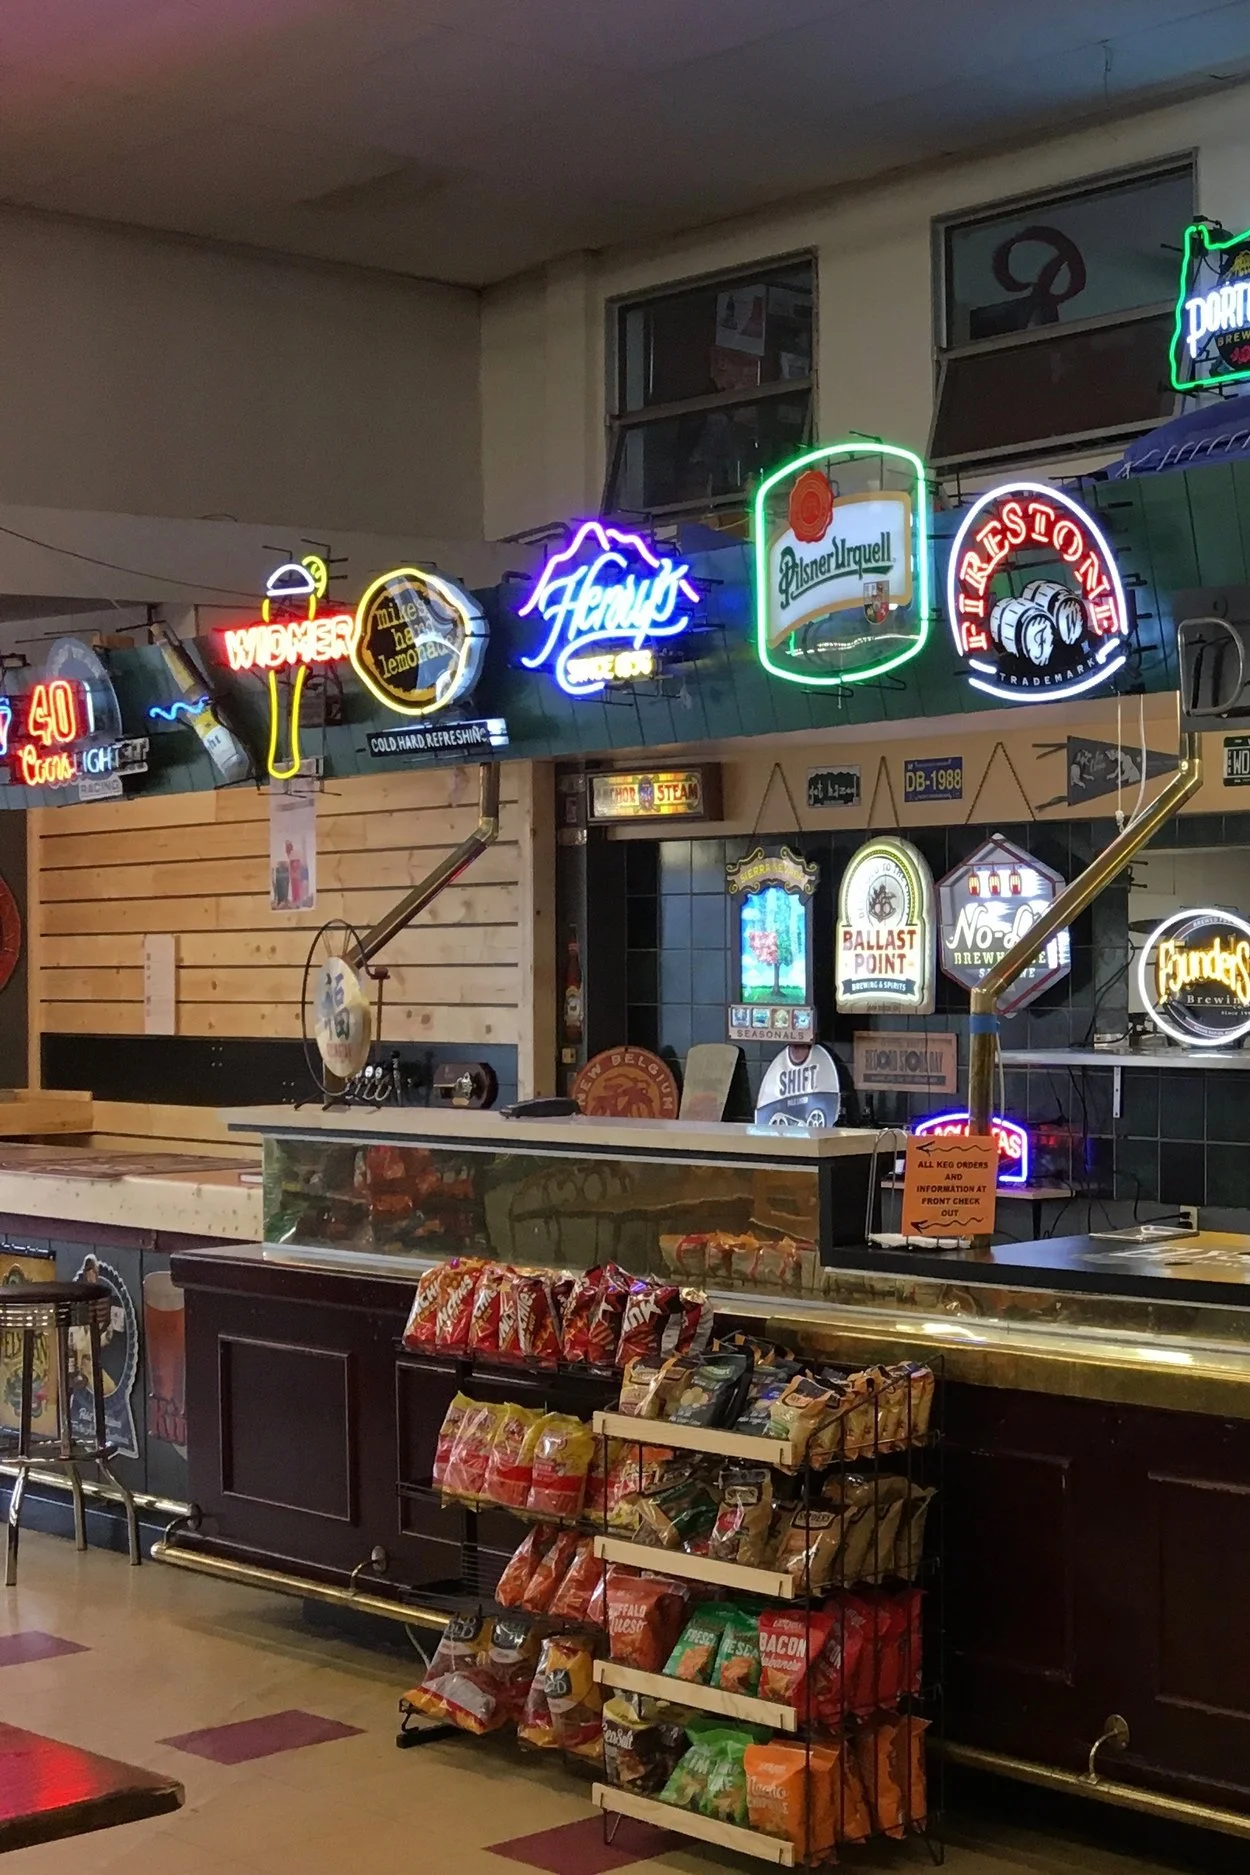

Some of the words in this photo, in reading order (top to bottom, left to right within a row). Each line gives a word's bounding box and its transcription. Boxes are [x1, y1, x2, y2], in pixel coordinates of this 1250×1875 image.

[778, 545, 835, 610] Pilsner
[831, 532, 892, 580] Urquell
[959, 501, 1119, 653] FIRESTONE
[999, 658, 1096, 687] TRADEMARK
[28, 680, 77, 746] 40
[18, 744, 74, 787] Coors
[905, 768, 963, 792] DB-1988
[657, 783, 698, 802] STEAM
[842, 929, 918, 951] BALLAST
[853, 953, 908, 975] POINT
[851, 981, 879, 992] BREWING
[883, 982, 907, 992] SPIRITS
[736, 1028, 805, 1041] SEASONALS
[577, 1066, 602, 1107] NEW
[610, 1053, 675, 1111] BELGIUM
[778, 1064, 819, 1097] SHIFT
[918, 1160, 934, 1169] ALL
[956, 1160, 989, 1169] ORDERS
[944, 1173, 963, 1181] AND
[916, 1185, 975, 1193] INFORMATION
[977, 1185, 987, 1193] AT
[921, 1197, 951, 1205] FRONT
[952, 1197, 981, 1205] CHECK
[940, 1209, 959, 1217] OUT
[759, 1632, 807, 1658] BACON
[747, 1776, 786, 1800] Nacho
